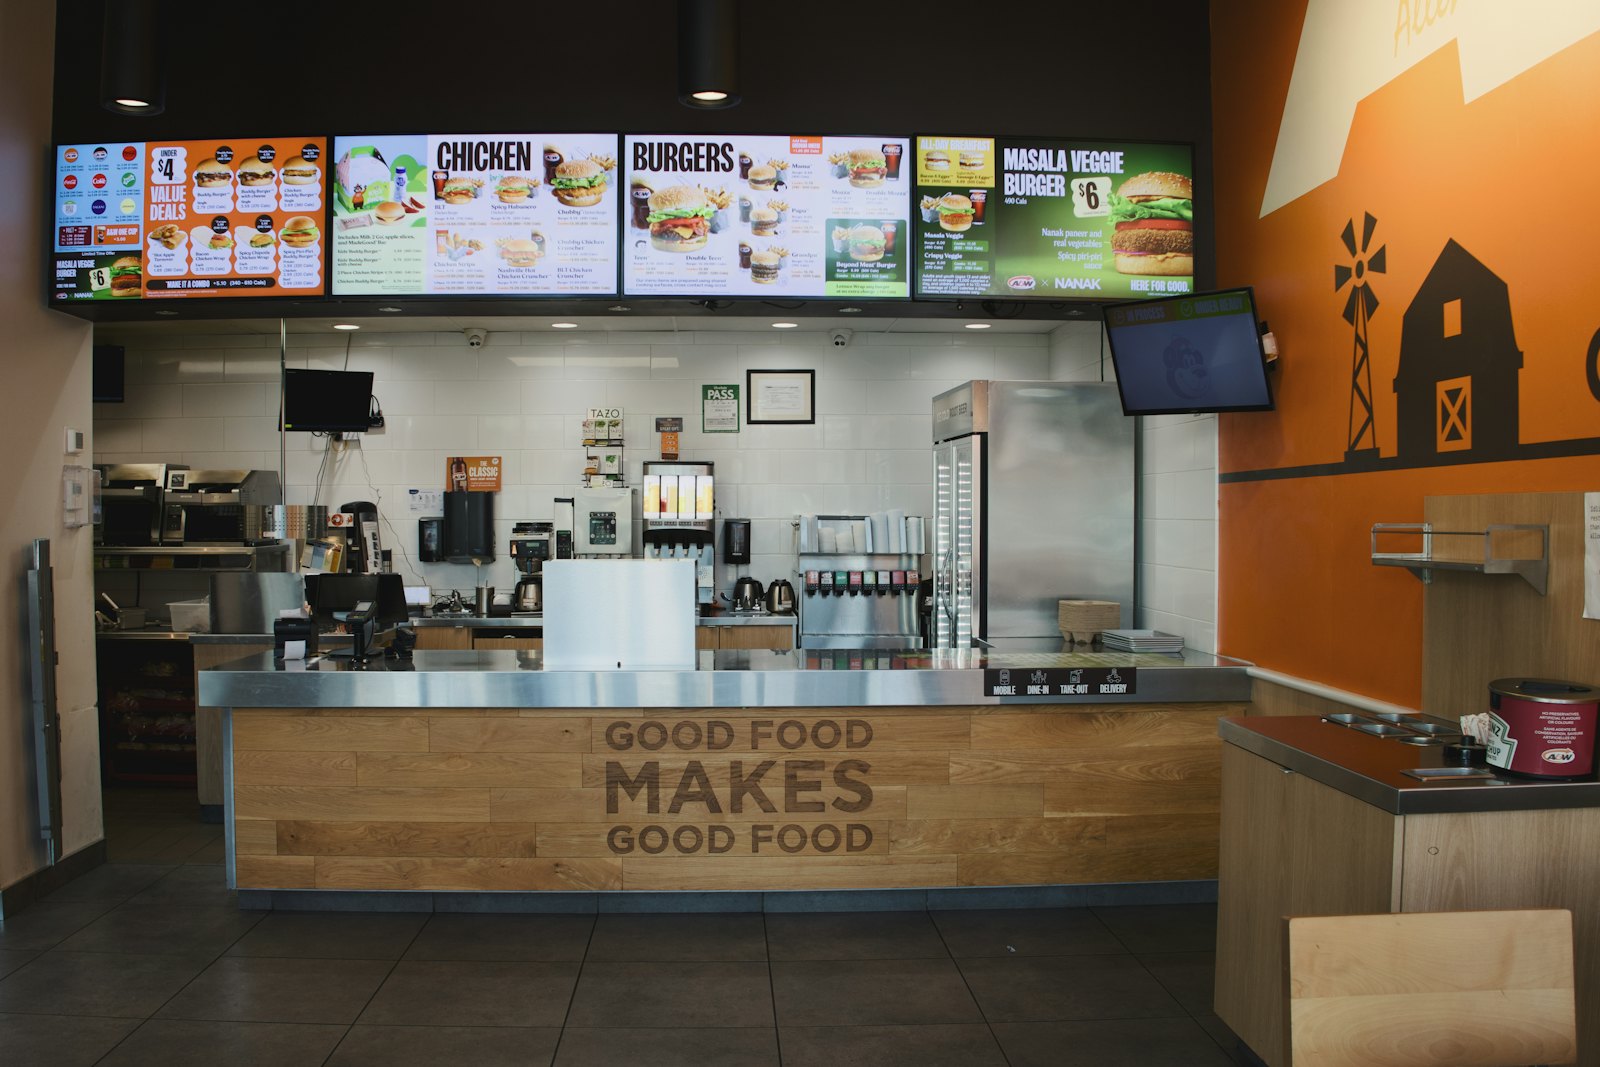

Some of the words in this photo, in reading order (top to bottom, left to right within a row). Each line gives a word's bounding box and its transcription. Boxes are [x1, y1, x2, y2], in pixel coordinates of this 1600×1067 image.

[920, 138, 949, 150] ALL-DAY
[950, 139, 991, 151] BREAKFAST
[161, 149, 177, 157] UNDER
[437, 141, 531, 172] CHICKEN
[633, 142, 734, 172] BURGERS
[1004, 148, 1068, 172] MASALA
[1071, 150, 1124, 174] VEGGIE
[158, 158, 174, 181] $4
[1004, 173, 1066, 197] BURGER
[150, 185, 187, 203] VALUE
[1078, 181, 1100, 209] $6
[150, 203, 186, 221] DEALS
[1042, 228, 1064, 237] Nanak
[1065, 230, 1088, 239] paneer
[1089, 230, 1102, 238] and
[1067, 240, 1102, 249] vegetables
[924, 252, 944, 260] Crispy
[1058, 251, 1077, 261] Spicy
[1077, 252, 1102, 262] piri-piri
[56, 260, 78, 269] MASALA
[77, 259, 95, 268] VEGGIE
[836, 261, 859, 269] Beyond
[56, 269, 77, 278] BURGER
[93, 270, 105, 286] $6
[1054, 278, 1101, 290] NANAK
[1130, 280, 1150, 291] HERE
[1151, 280, 1166, 292] FOR
[1167, 281, 1190, 293] GOOD.
[1134, 306, 1166, 321] PROCESS
[1194, 301, 1219, 314] ORDER
[707, 389, 735, 400] PASS
[590, 408, 620, 418] TAZO
[958, 402, 967, 415] BEER
[469, 466, 498, 477] CLASSIC
[993, 685, 1016, 695] MOBILE
[1027, 685, 1049, 695] DINE-IN
[1059, 684, 1089, 694] TAKE-OUT
[1100, 684, 1127, 694] DELIVERY
[605, 720, 735, 750] GOOD
[751, 719, 873, 750] FOOD
[1547, 753, 1573, 761] A&W
[605, 759, 874, 814] MAKES
[606, 824, 735, 854] GOOD
[751, 823, 873, 853] FOOD
